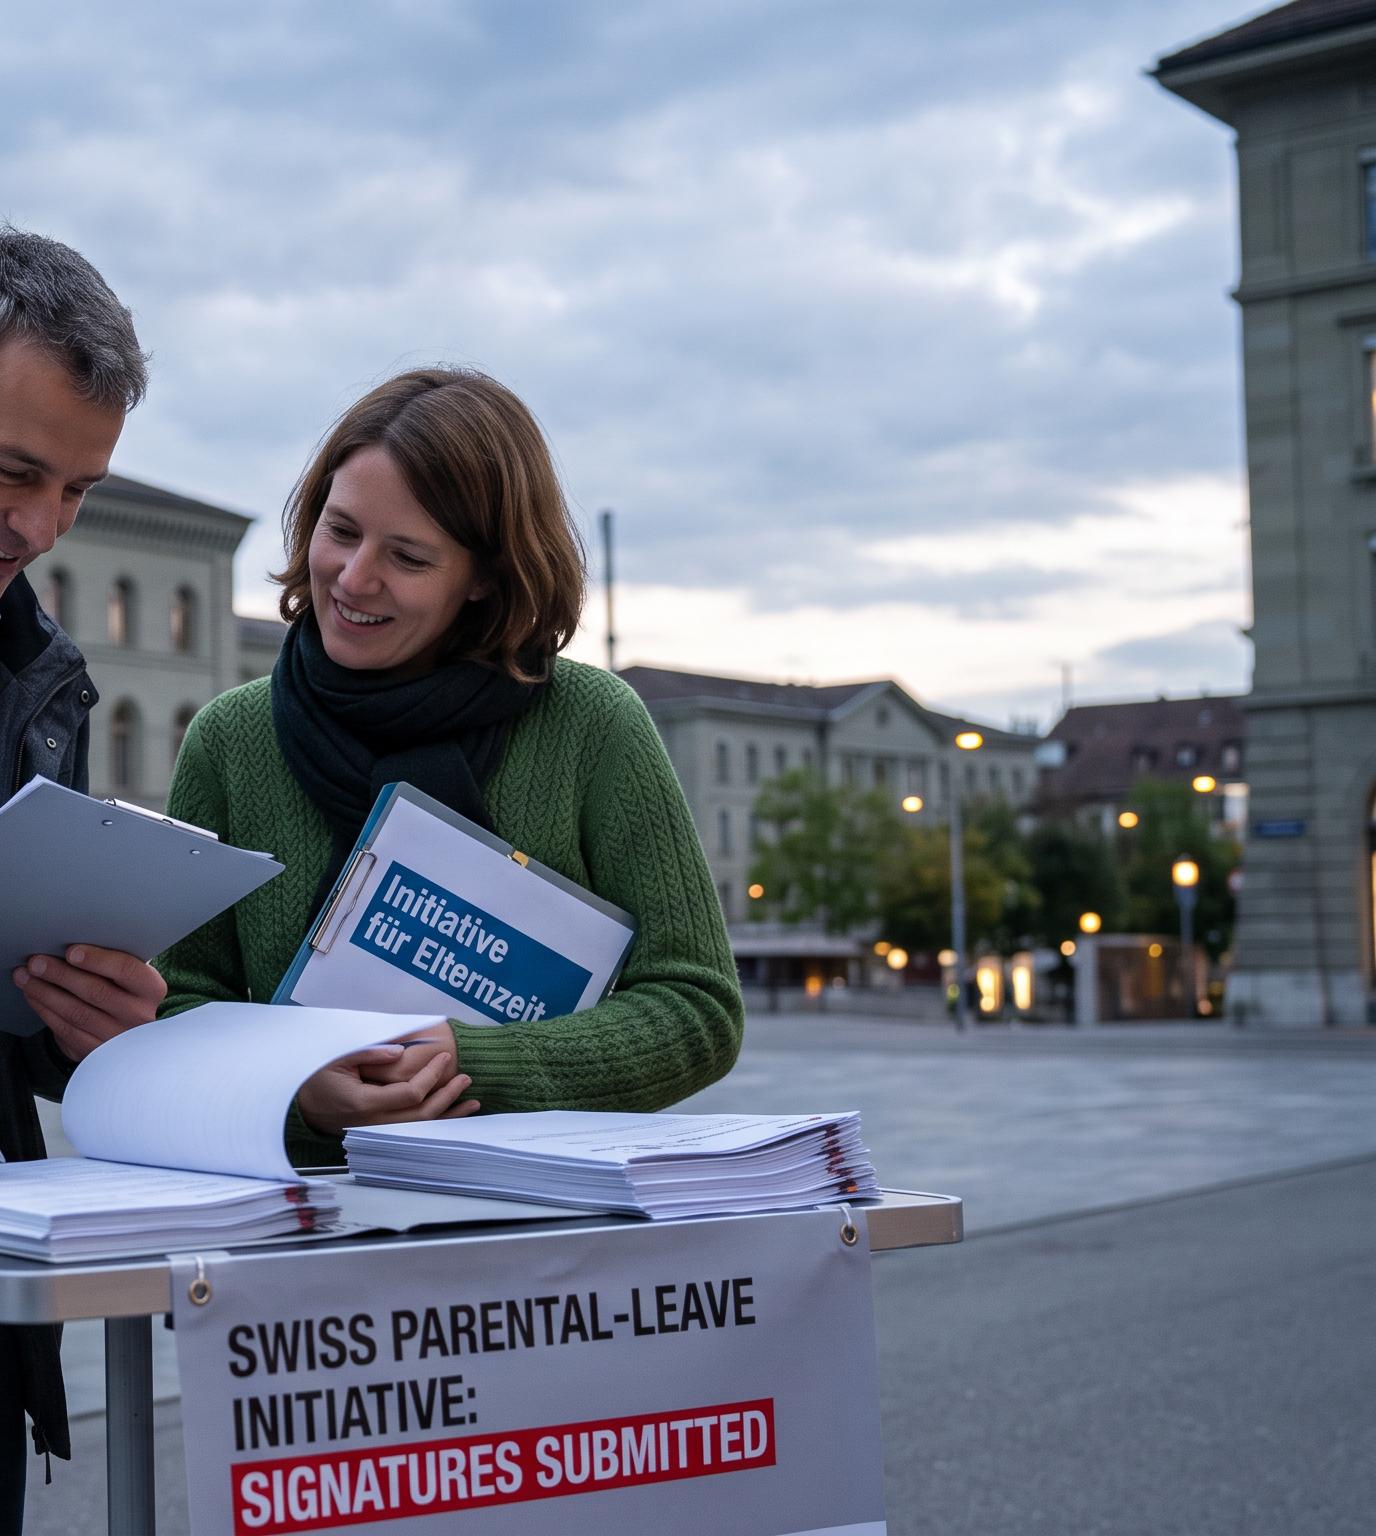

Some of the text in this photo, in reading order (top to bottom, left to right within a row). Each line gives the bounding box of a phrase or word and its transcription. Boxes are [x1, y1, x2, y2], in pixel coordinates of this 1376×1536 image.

[364, 912, 546, 1023] für Elternzeit
[383, 875, 509, 963] Initiative
[227, 1277, 756, 1379] SWISS PARENTAL-LEAVE
[233, 1374, 478, 1452] INITIATIVE:
[241, 1410, 768, 1527] SIGNATURES SUBMITTED
